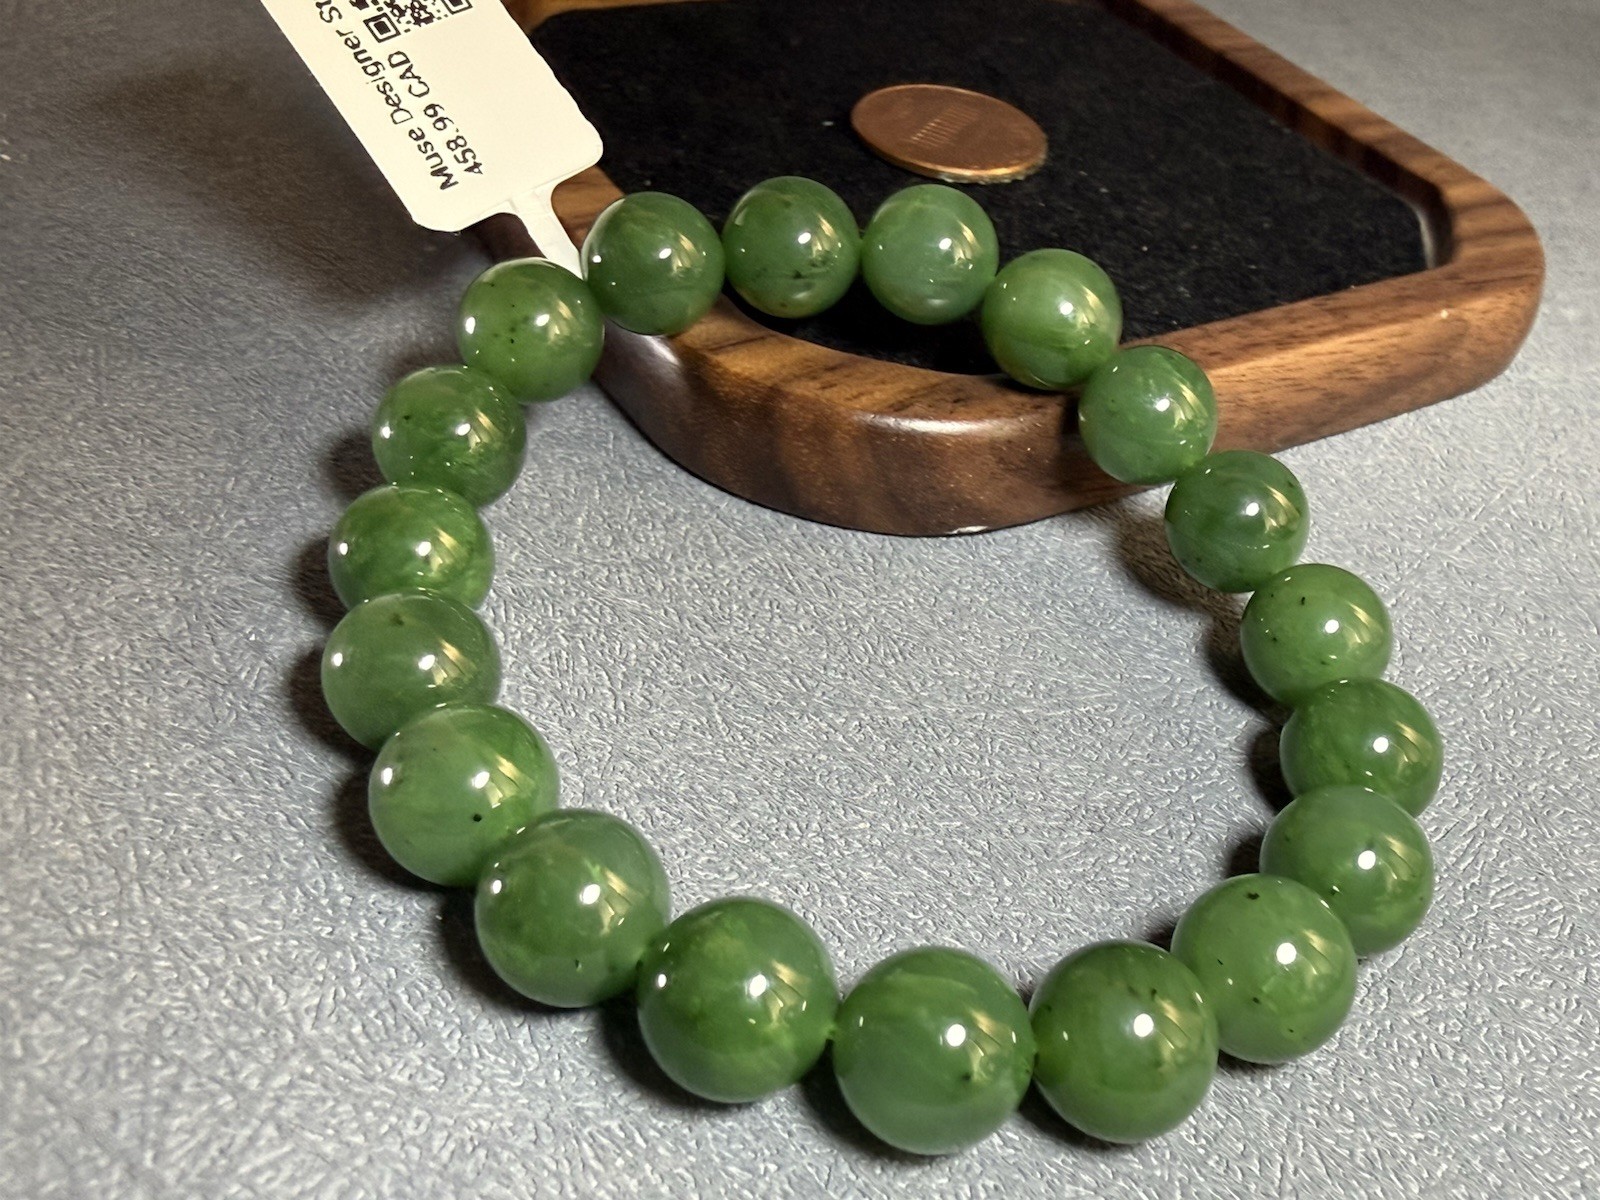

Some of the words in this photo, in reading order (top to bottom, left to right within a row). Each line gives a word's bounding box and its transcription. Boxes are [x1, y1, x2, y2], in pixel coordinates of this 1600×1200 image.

[335, 29, 414, 125] Designer
[387, 50, 430, 98] CAD
[408, 127, 459, 190] Muse
[422, 103, 483, 175] 458.99
